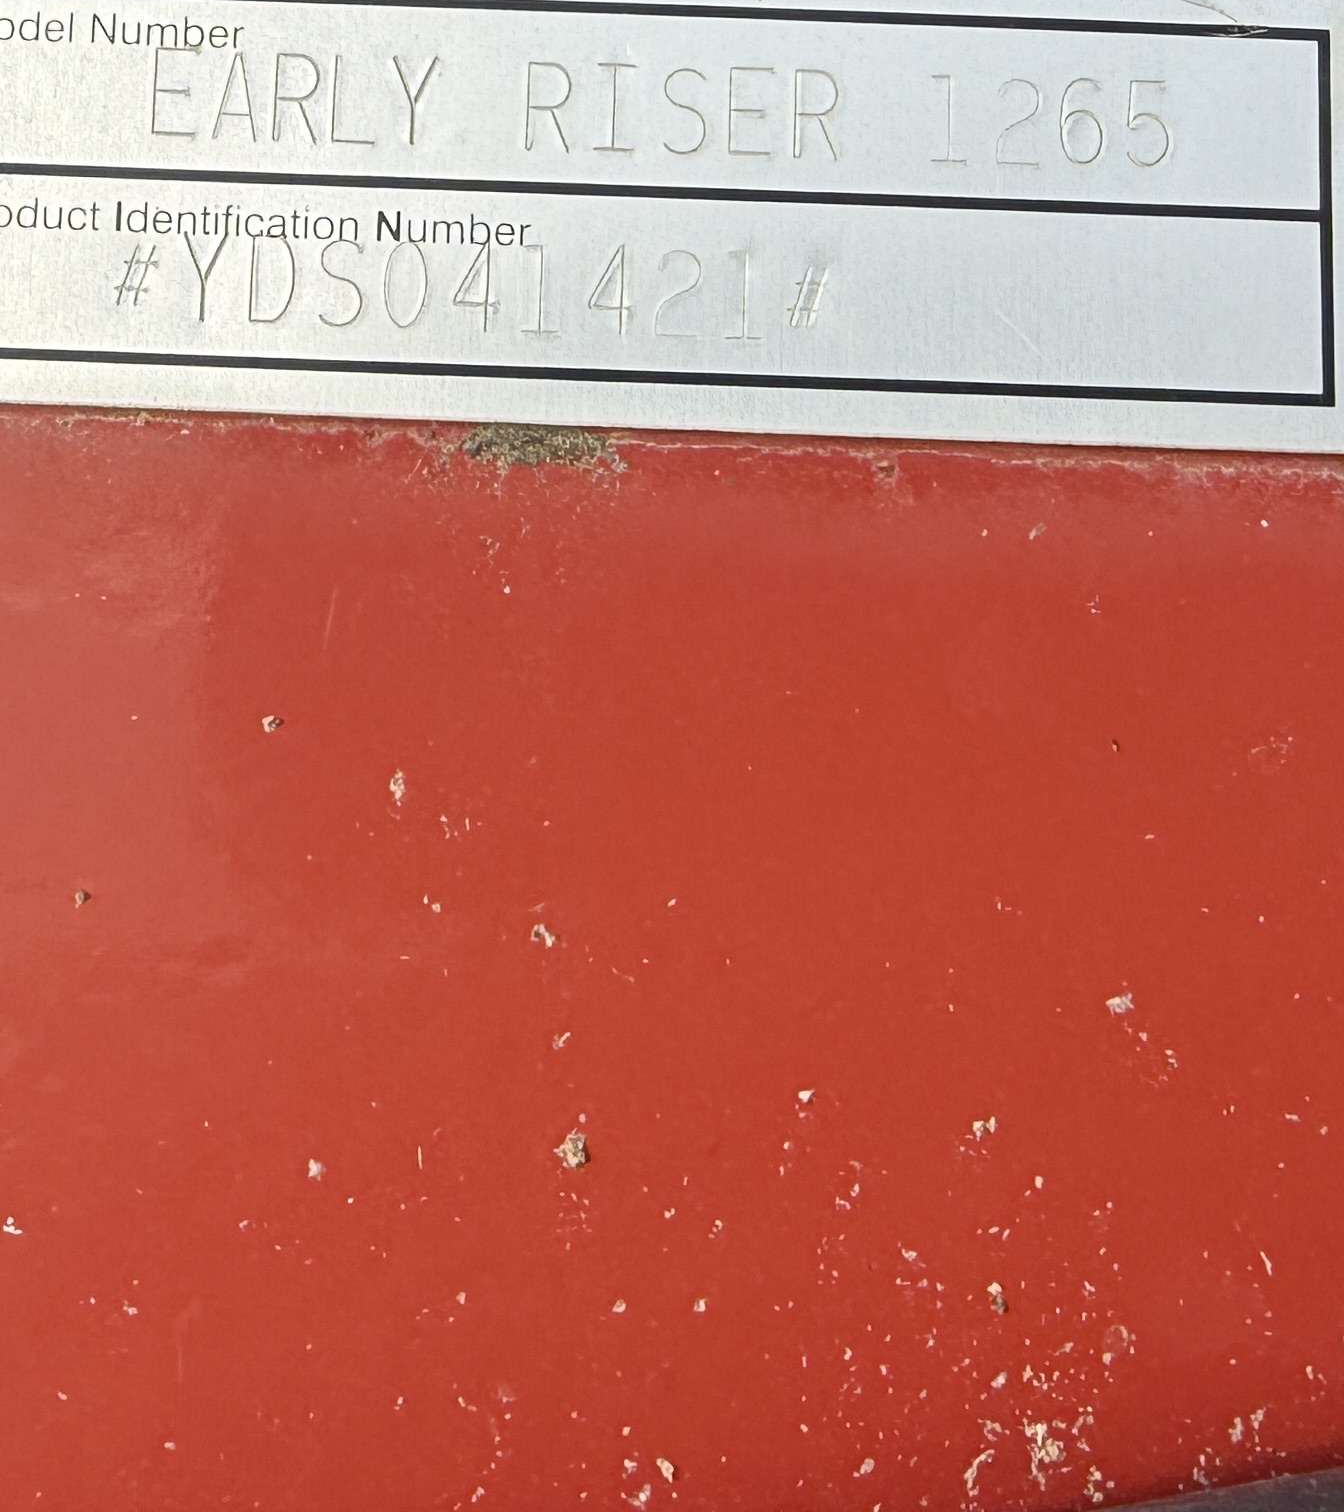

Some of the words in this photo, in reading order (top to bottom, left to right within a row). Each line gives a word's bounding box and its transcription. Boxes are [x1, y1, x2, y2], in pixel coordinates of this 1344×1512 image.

[91, 13, 244, 50] Number
[151, 46, 440, 147] EARLY
[524, 59, 843, 162] RISER
[930, 74, 1175, 169] 1265
[115, 199, 360, 243] Identification
[375, 209, 532, 247] Number
[113, 232, 831, 342] #YDS041421#
